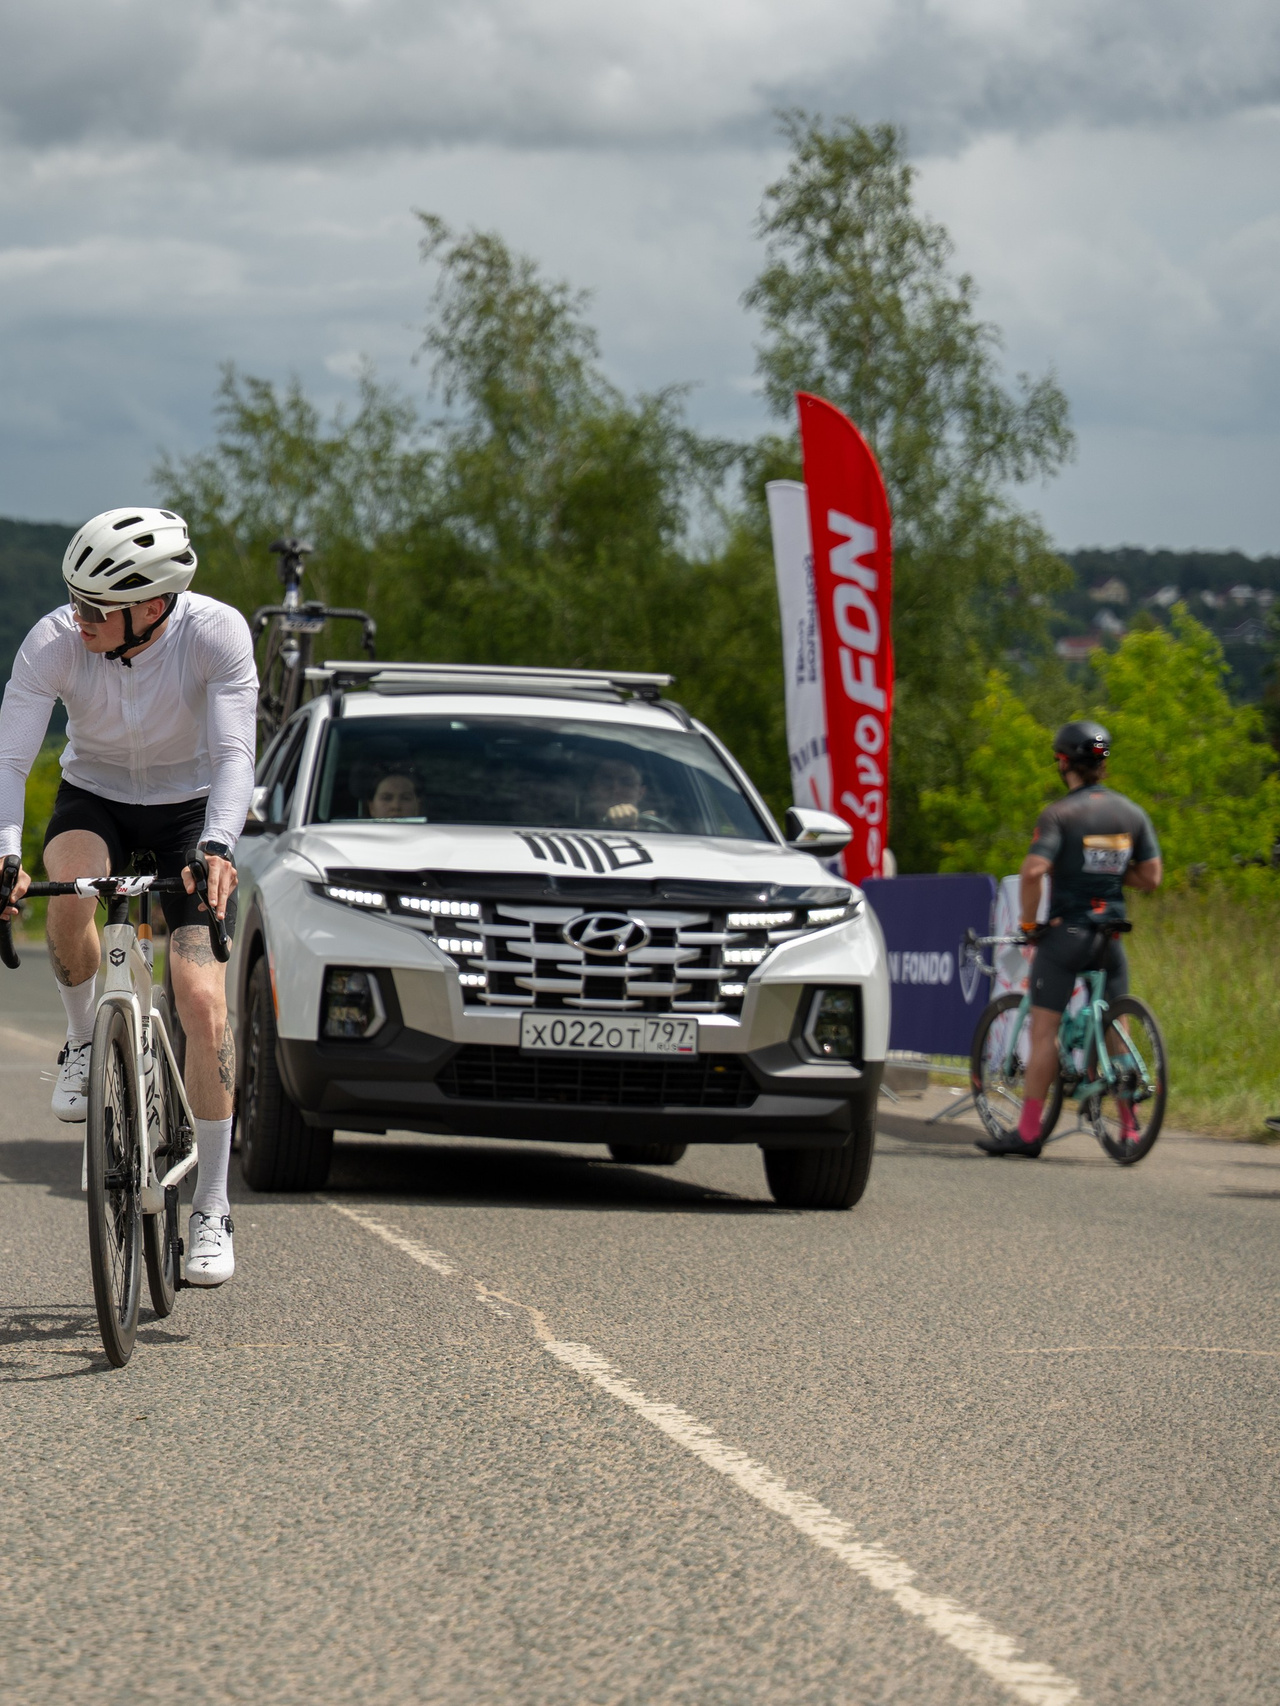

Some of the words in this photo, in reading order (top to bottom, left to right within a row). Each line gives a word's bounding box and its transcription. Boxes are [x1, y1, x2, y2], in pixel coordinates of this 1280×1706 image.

[901, 951, 954, 985] FONDO
[648, 1021, 689, 1043] 797
[657, 1043, 677, 1051] RUS
